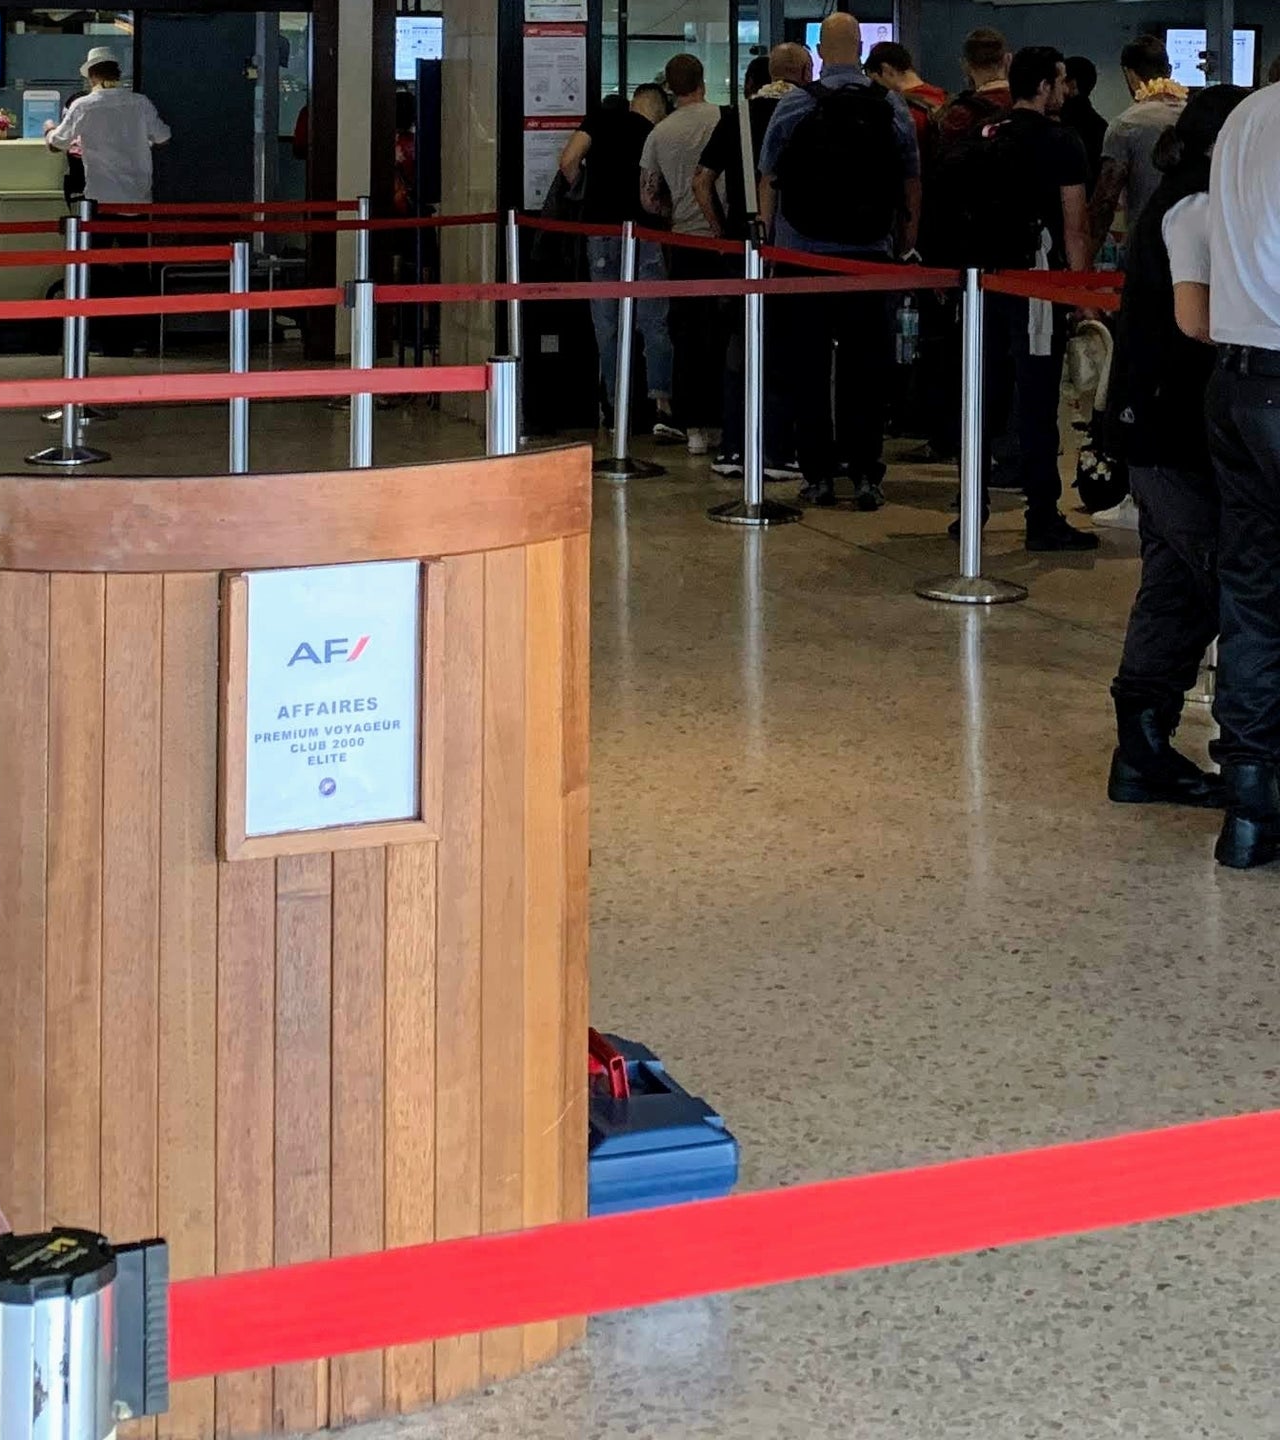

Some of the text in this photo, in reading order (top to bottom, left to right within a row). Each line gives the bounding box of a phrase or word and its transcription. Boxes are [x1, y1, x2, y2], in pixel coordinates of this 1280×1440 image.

[277, 696, 379, 720] AFFAIRES
[254, 719, 401, 743] PREMIUM VOYAGEUR
[290, 737, 365, 754] CLUB 2000
[307, 752, 347, 766] ELITE
